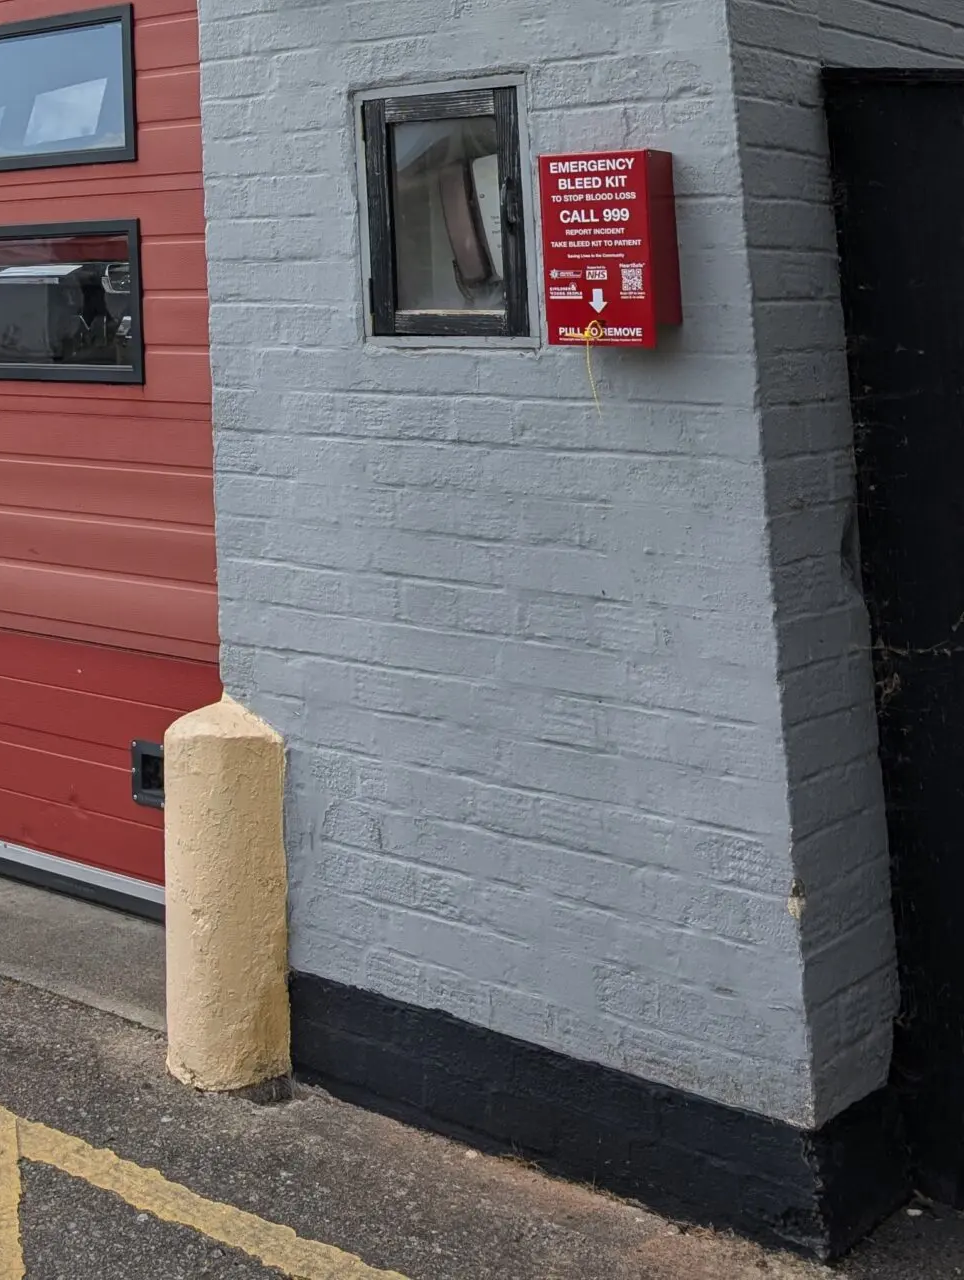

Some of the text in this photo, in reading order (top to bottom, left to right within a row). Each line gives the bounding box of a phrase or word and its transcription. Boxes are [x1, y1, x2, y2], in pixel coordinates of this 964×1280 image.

[549, 157, 635, 174] EMERGENCY
[558, 175, 628, 190] BLEED KIT
[551, 192, 636, 203] TO STOP BLOOD LOSS
[559, 208, 630, 224] CALL 999
[565, 227, 625, 236] REPORT INCIDENT
[568, 240, 591, 248] BLEED
[603, 239, 613, 247] TO
[587, 271, 606, 279] NHS
[558, 327, 581, 337] PULL
[602, 327, 643, 337] REMOVE
